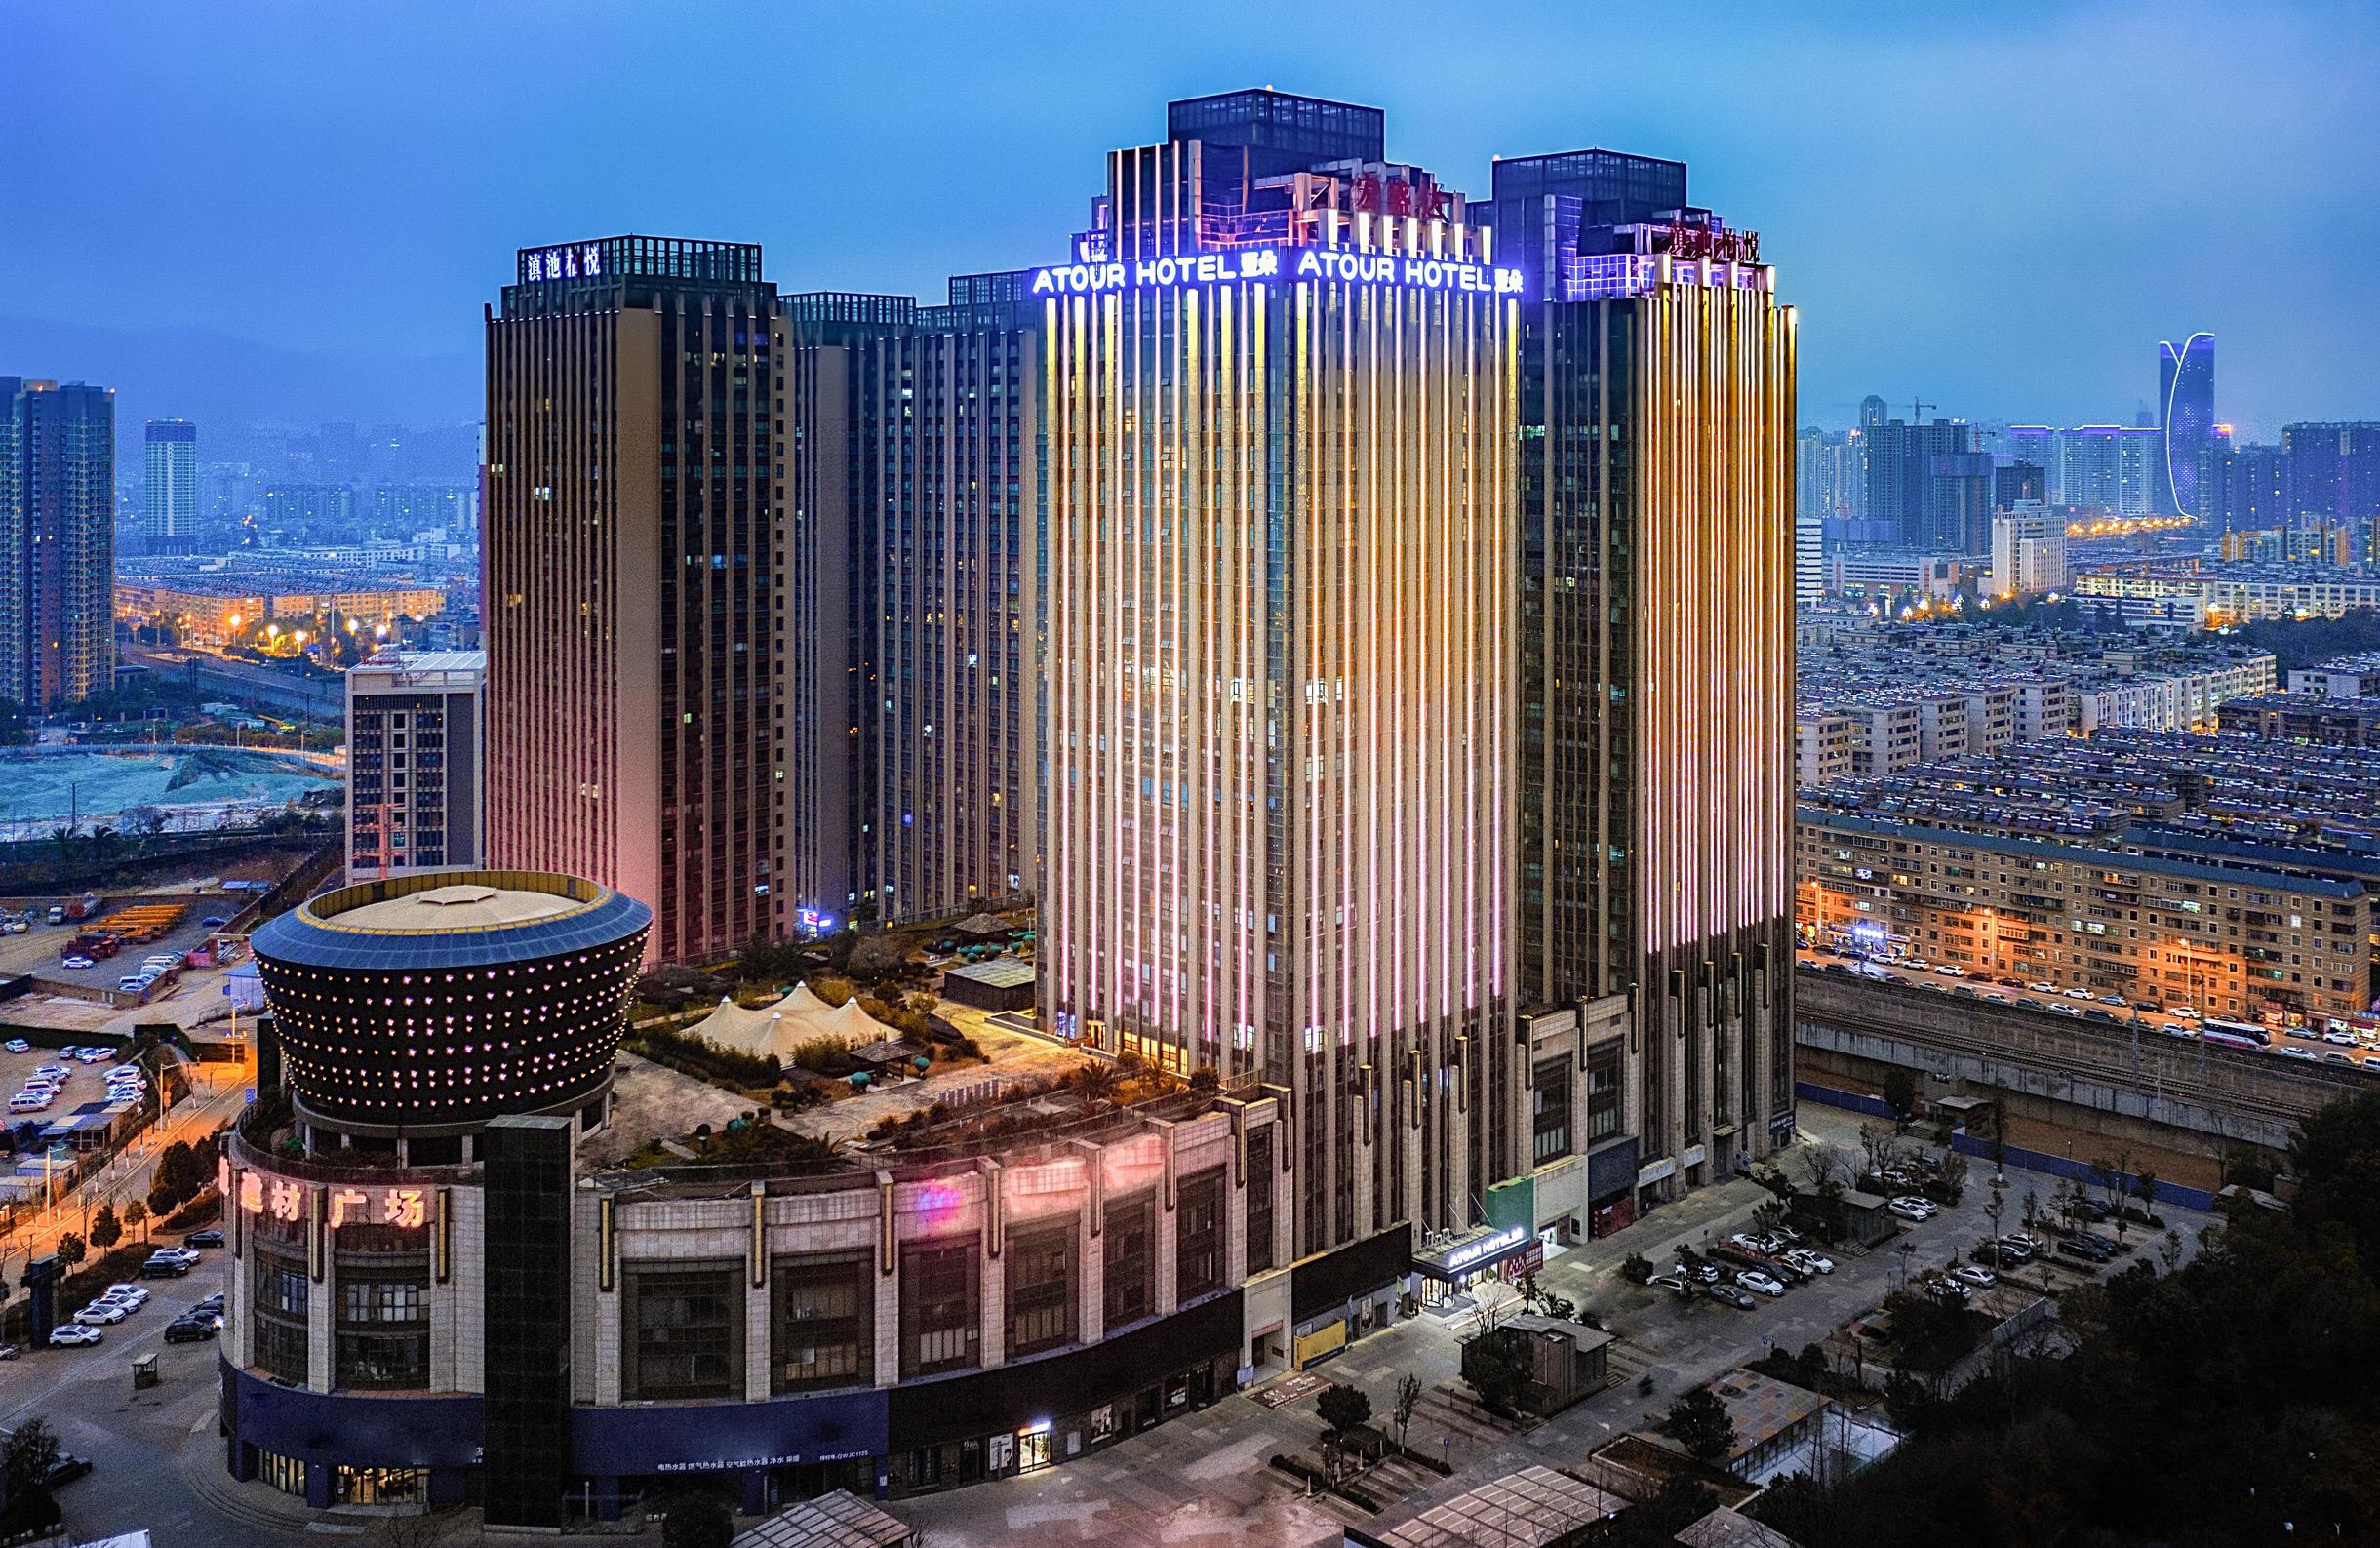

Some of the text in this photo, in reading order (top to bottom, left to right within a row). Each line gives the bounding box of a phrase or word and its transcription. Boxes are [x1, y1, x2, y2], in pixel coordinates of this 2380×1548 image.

[1032, 264, 1126, 294] ATOUR
[1136, 255, 1237, 286] HOTEL
[1298, 251, 1395, 283] ATOUR
[1405, 259, 1492, 292] HOTEL
